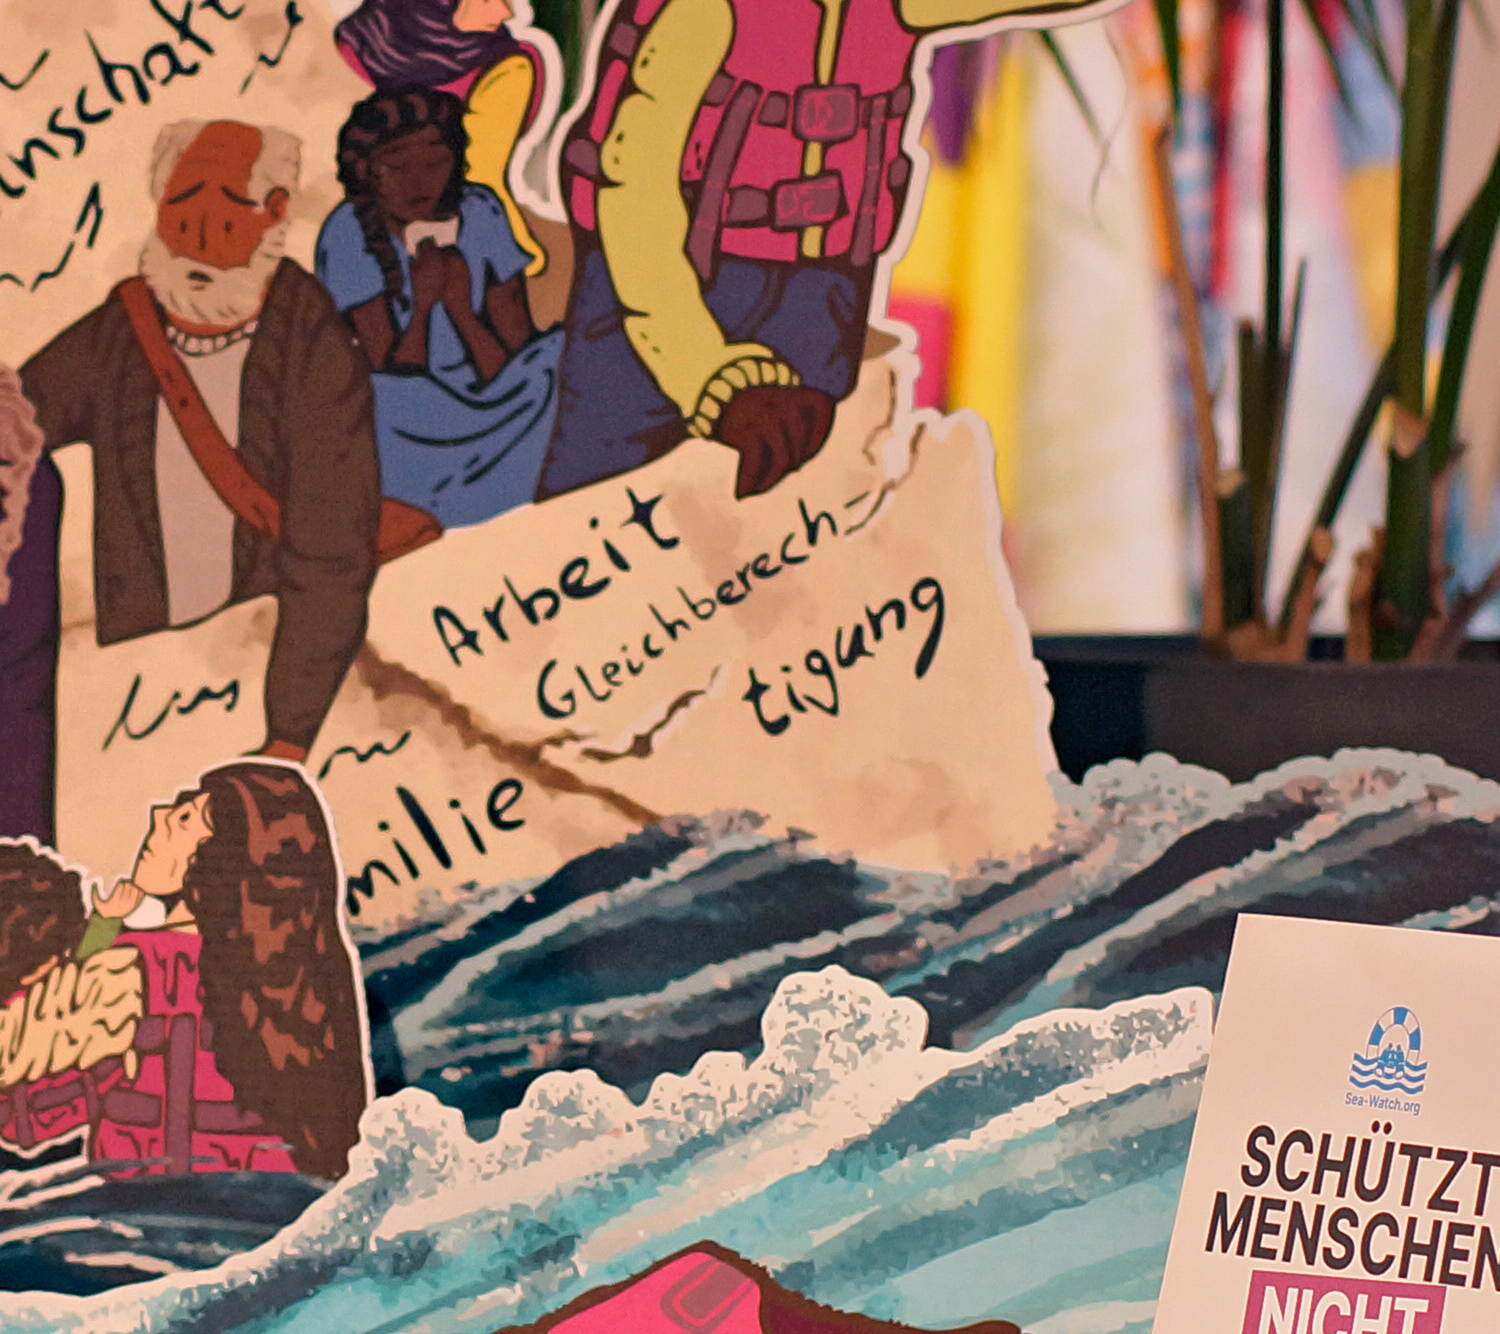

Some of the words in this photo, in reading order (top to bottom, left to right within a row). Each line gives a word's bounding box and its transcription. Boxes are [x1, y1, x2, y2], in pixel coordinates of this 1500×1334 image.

[433, 485, 681, 667] Arbeit
[536, 493, 870, 719] Gleichberech-
[742, 575, 946, 736] tigung
[346, 778, 526, 916] milie
[1345, 1092, 1421, 1116] Sea-Watch.org
